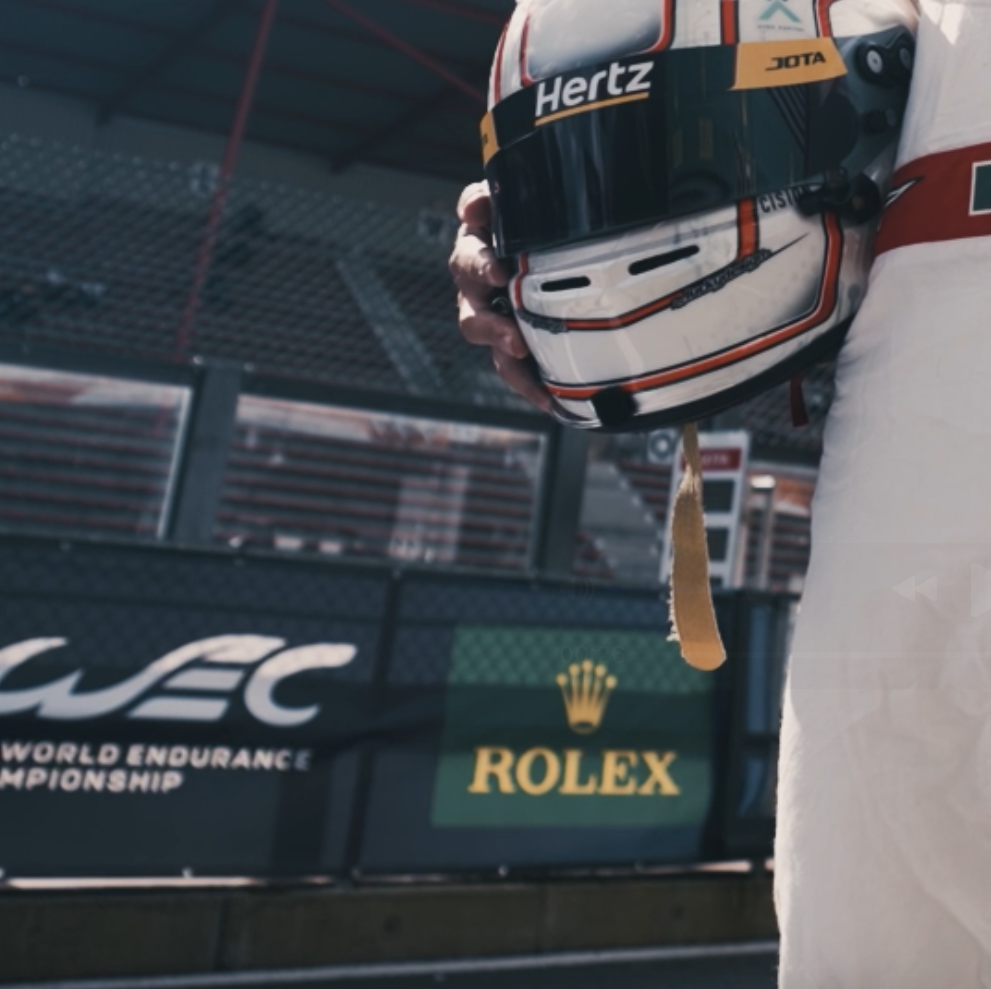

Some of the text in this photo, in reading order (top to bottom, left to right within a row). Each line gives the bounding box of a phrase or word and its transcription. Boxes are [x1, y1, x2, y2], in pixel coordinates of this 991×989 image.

[764, 51, 827, 71] JOTA
[535, 60, 655, 117] Hertz
[0, 634, 357, 726] WEC
[1, 742, 312, 772] WORLD ENDURANCE
[469, 747, 680, 796] ROLEX
[0, 768, 184, 793] MPIONSHIP
